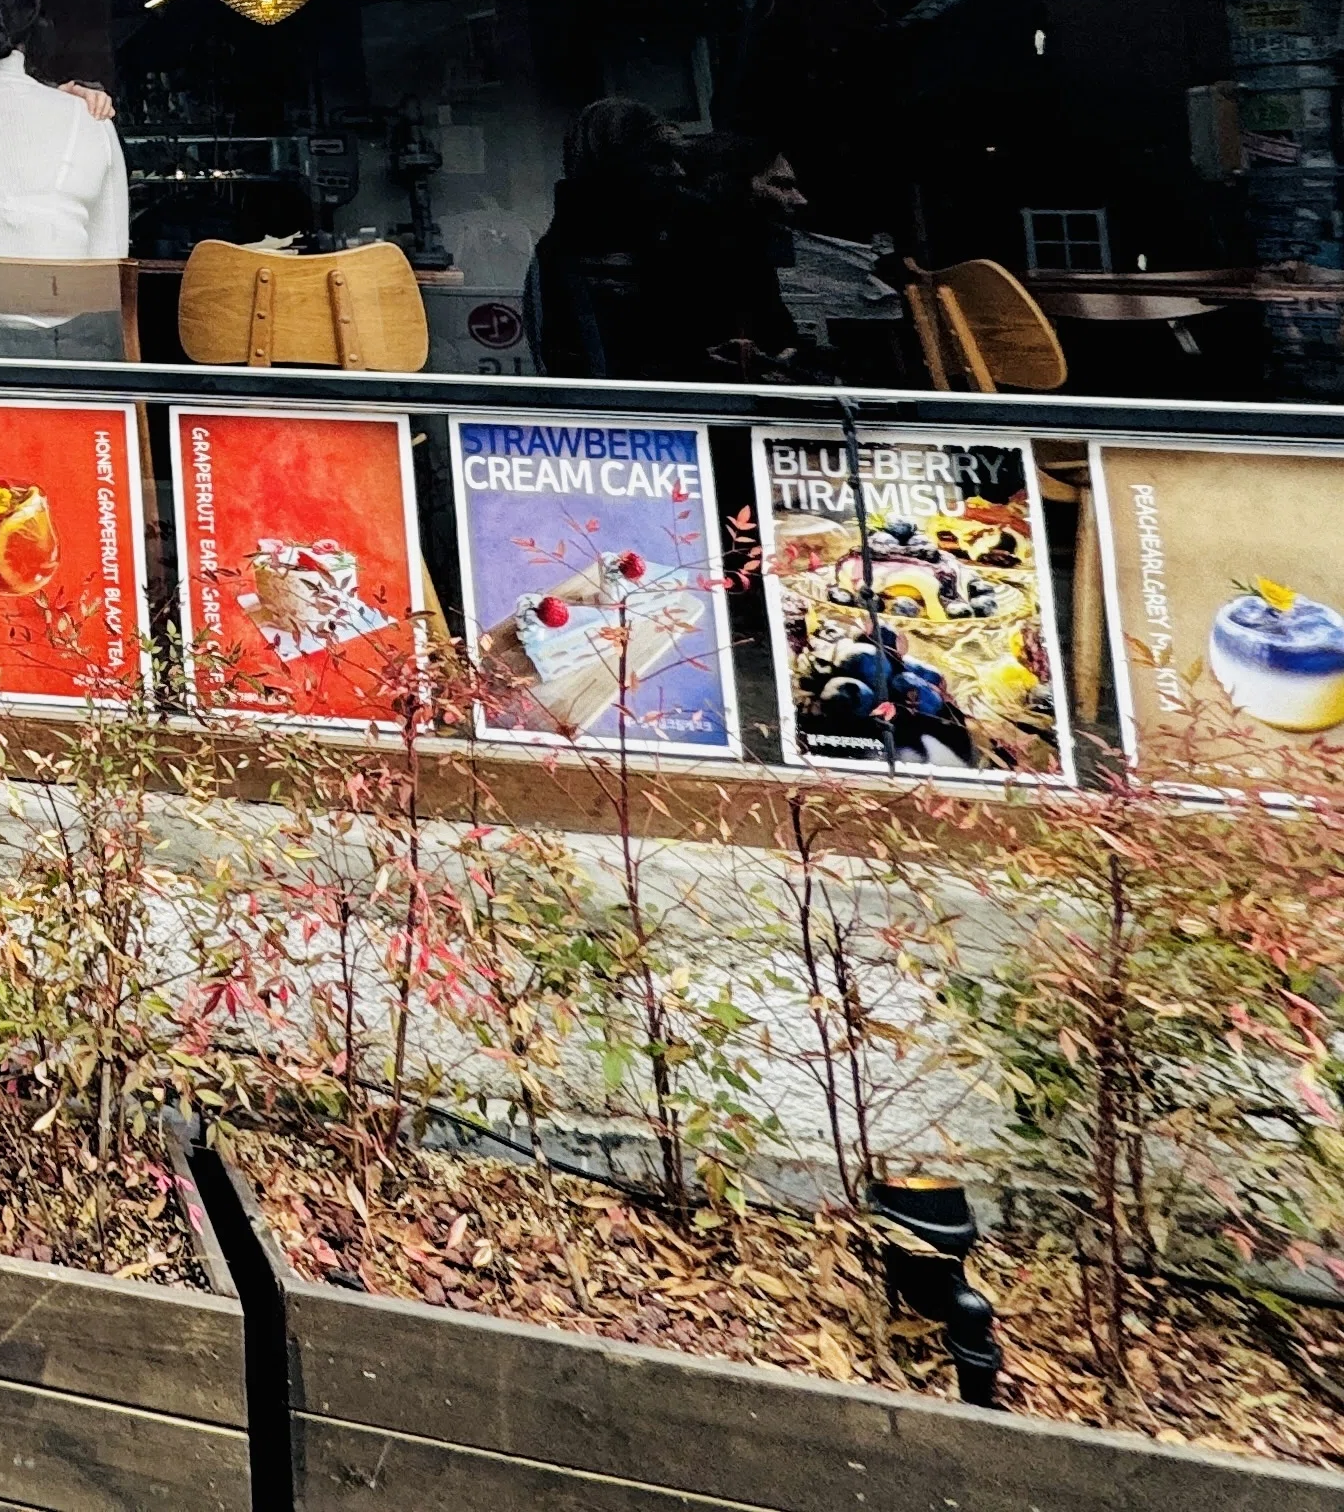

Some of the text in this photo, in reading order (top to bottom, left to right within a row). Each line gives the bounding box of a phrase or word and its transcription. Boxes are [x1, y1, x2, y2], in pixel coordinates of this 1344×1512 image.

[464, 424, 697, 462] STRAWBERRY
[771, 445, 1005, 485] BLUEBERRY
[191, 427, 216, 533] GRAPEFRUIT
[464, 455, 701, 499] CREAM CAKE
[772, 477, 966, 517] TIRAMISU
[93, 431, 125, 668] HONEY GRAPEFRUIT BLACK TEA
[1128, 484, 1173, 629] PEACHEARLGREY
[202, 588, 224, 637] GREY
